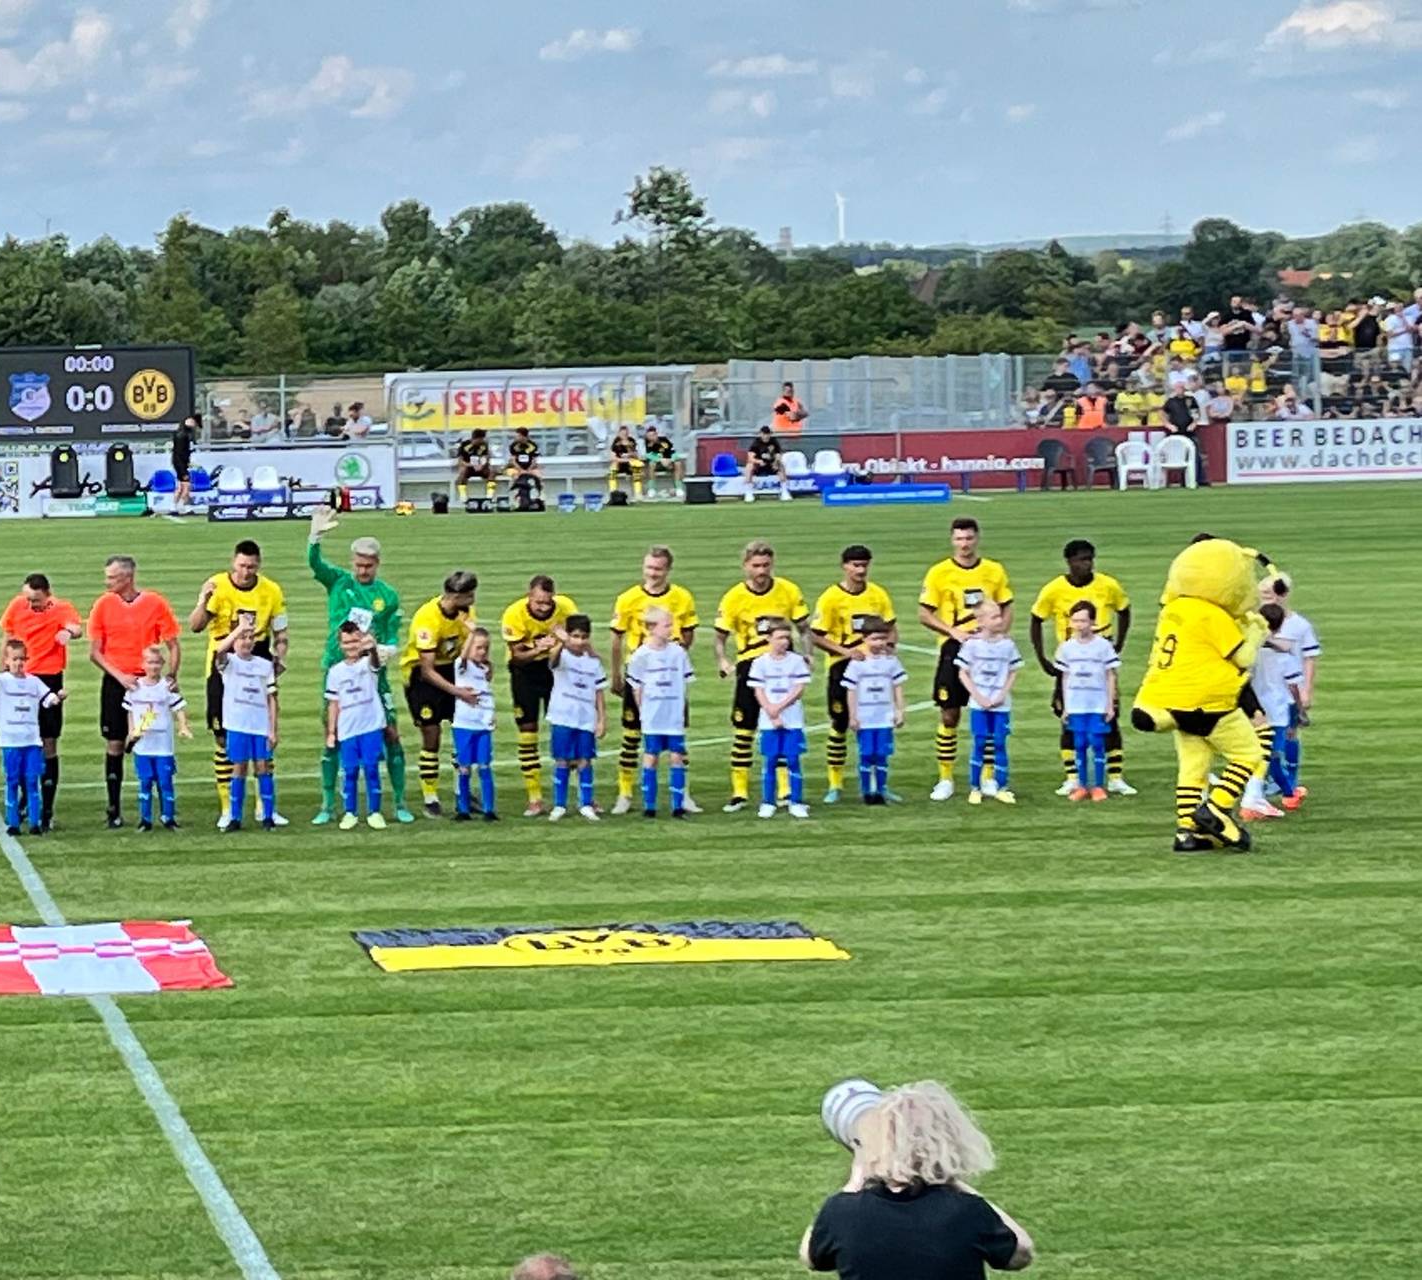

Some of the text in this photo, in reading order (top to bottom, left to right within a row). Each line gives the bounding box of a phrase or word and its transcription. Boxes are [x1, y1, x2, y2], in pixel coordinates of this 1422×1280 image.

[64, 355, 114, 372] 00:00
[65, 385, 114, 412] 0:0
[132, 375, 168, 404] BVB
[1235, 429, 1304, 448] BEER
[1236, 448, 1422, 469] www.dachdec
